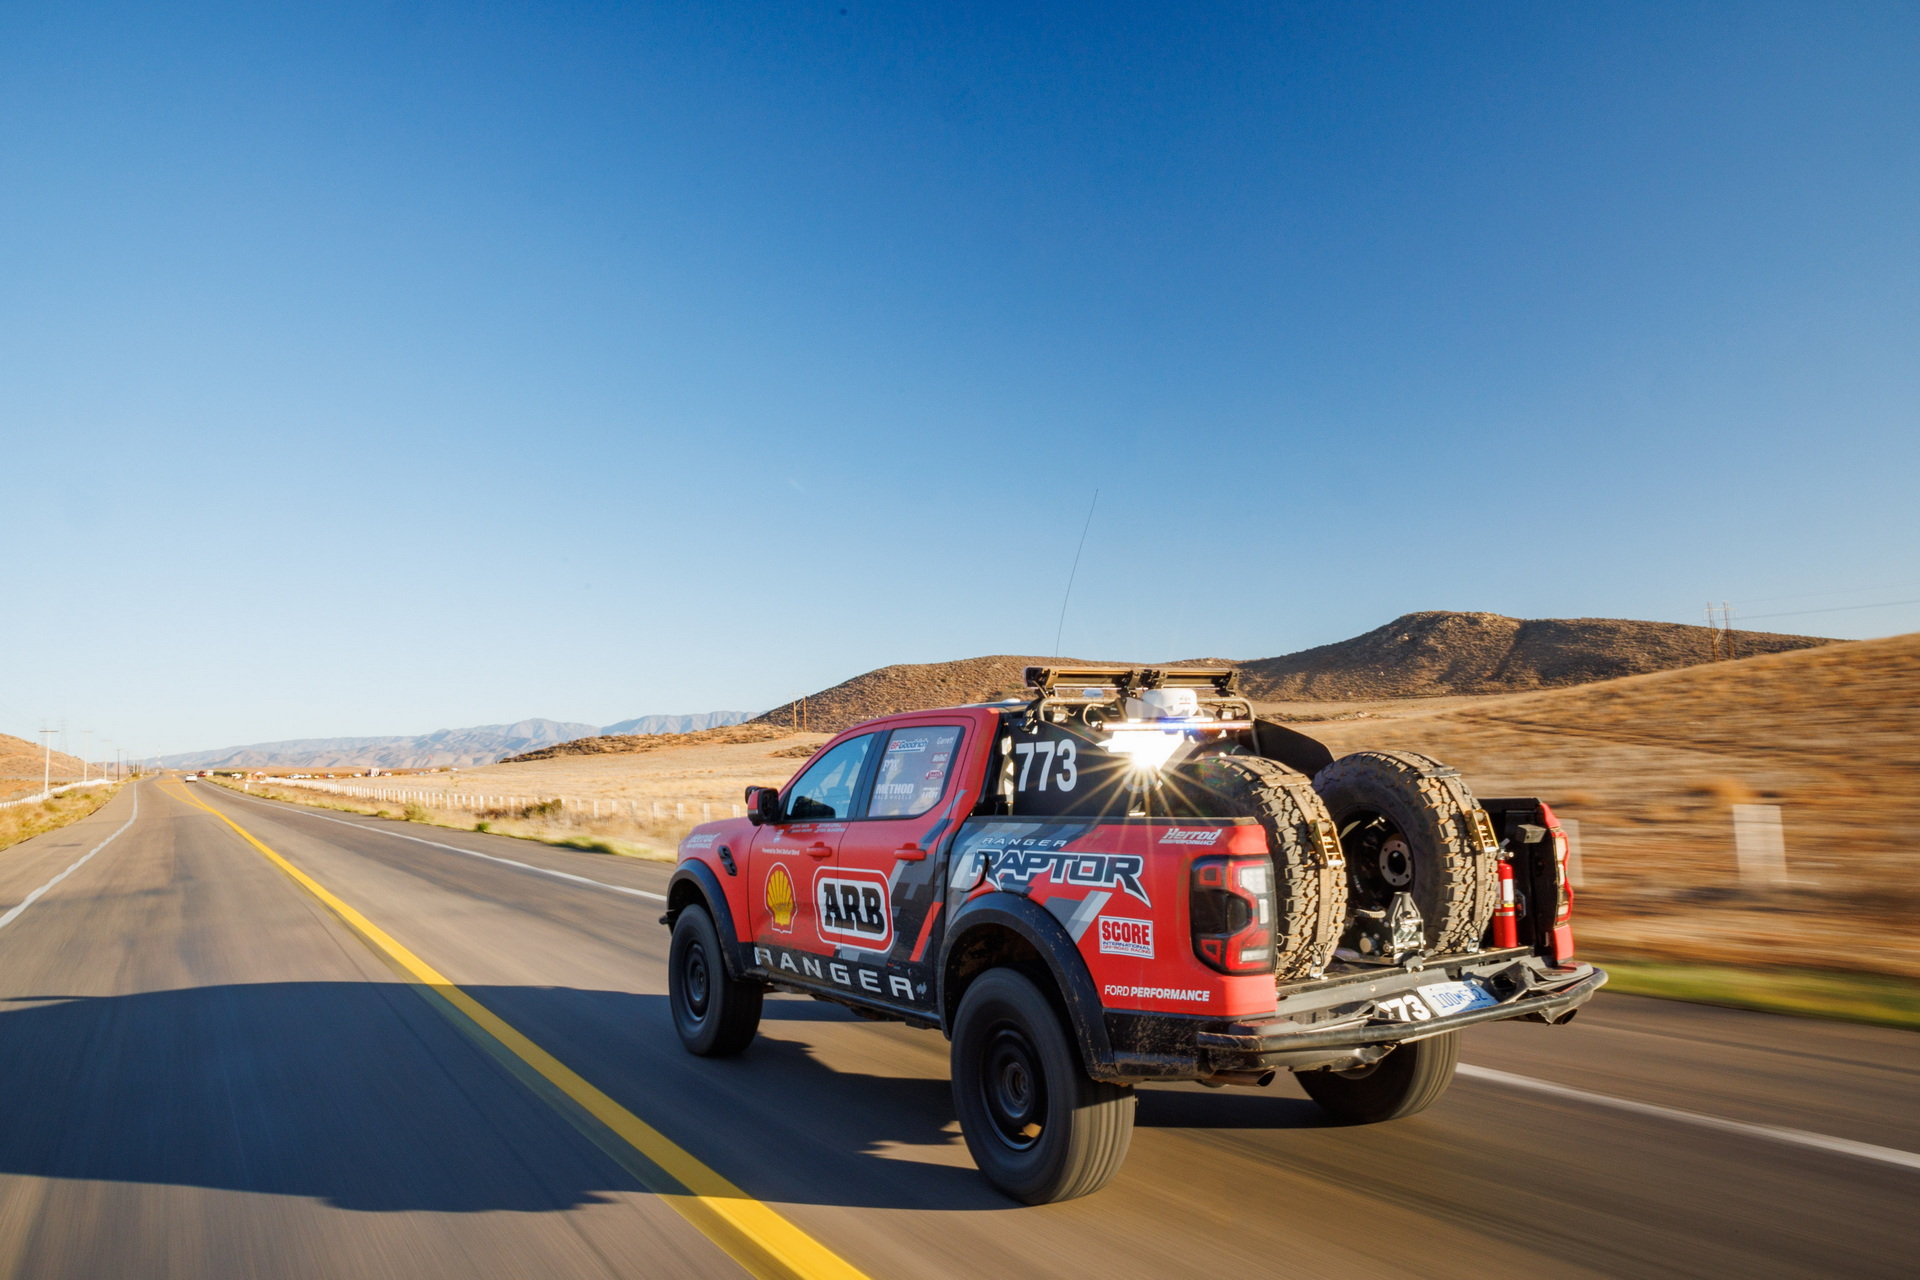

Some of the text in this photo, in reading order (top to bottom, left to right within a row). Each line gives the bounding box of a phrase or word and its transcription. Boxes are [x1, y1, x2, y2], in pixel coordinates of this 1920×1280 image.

[890, 738, 928, 750] BFGoodrich
[1016, 739, 1077, 792] 773
[876, 784, 914, 795] METHOD
[1163, 828, 1223, 840] Herrod
[982, 837, 1067, 847] RANGER
[969, 849, 1152, 909] RAPTOR
[824, 883, 884, 934] ARB
[1102, 921, 1150, 946] SCORE
[1103, 941, 1150, 951] INTERNATIONAL
[1130, 947, 1151, 955] RACING
[754, 947, 915, 1001] RANGER
[1104, 985, 1210, 1002] FORD PERFORMANCE
